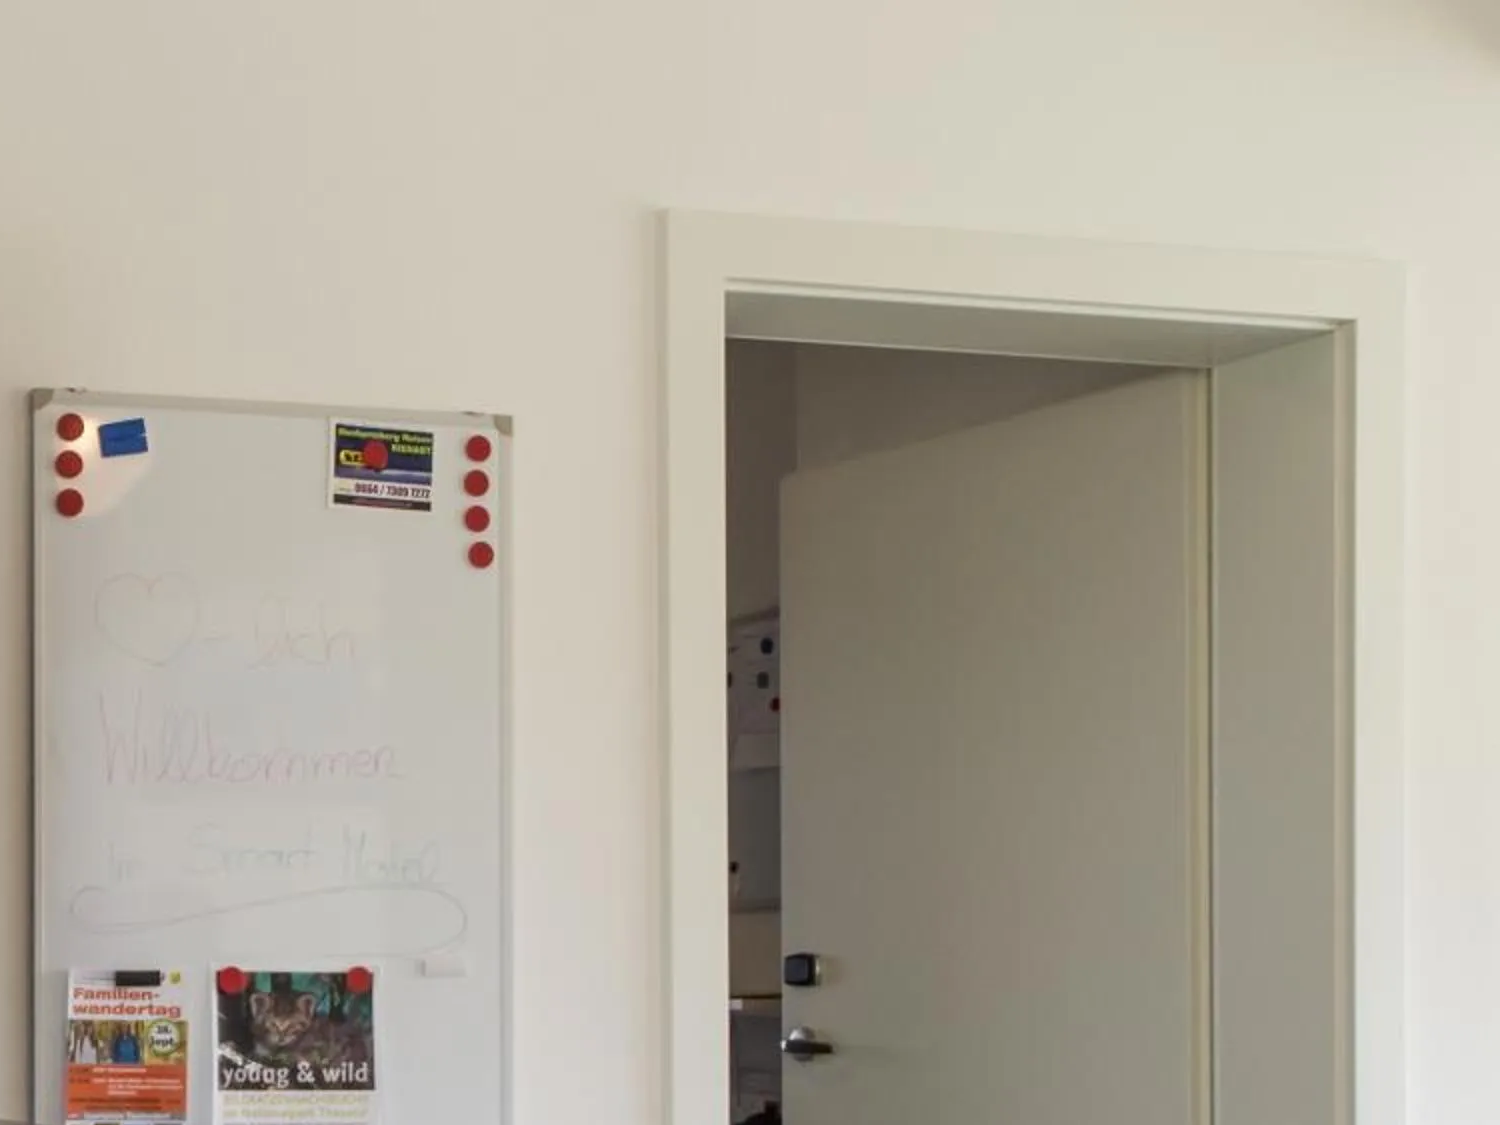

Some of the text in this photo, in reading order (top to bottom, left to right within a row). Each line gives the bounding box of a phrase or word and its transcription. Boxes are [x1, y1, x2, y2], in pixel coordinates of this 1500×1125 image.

[97, 687, 407, 785] Willkommen
[73, 1003, 181, 1018] wandertag
[297, 1060, 315, 1083] &
[322, 1062, 369, 1083] wild
